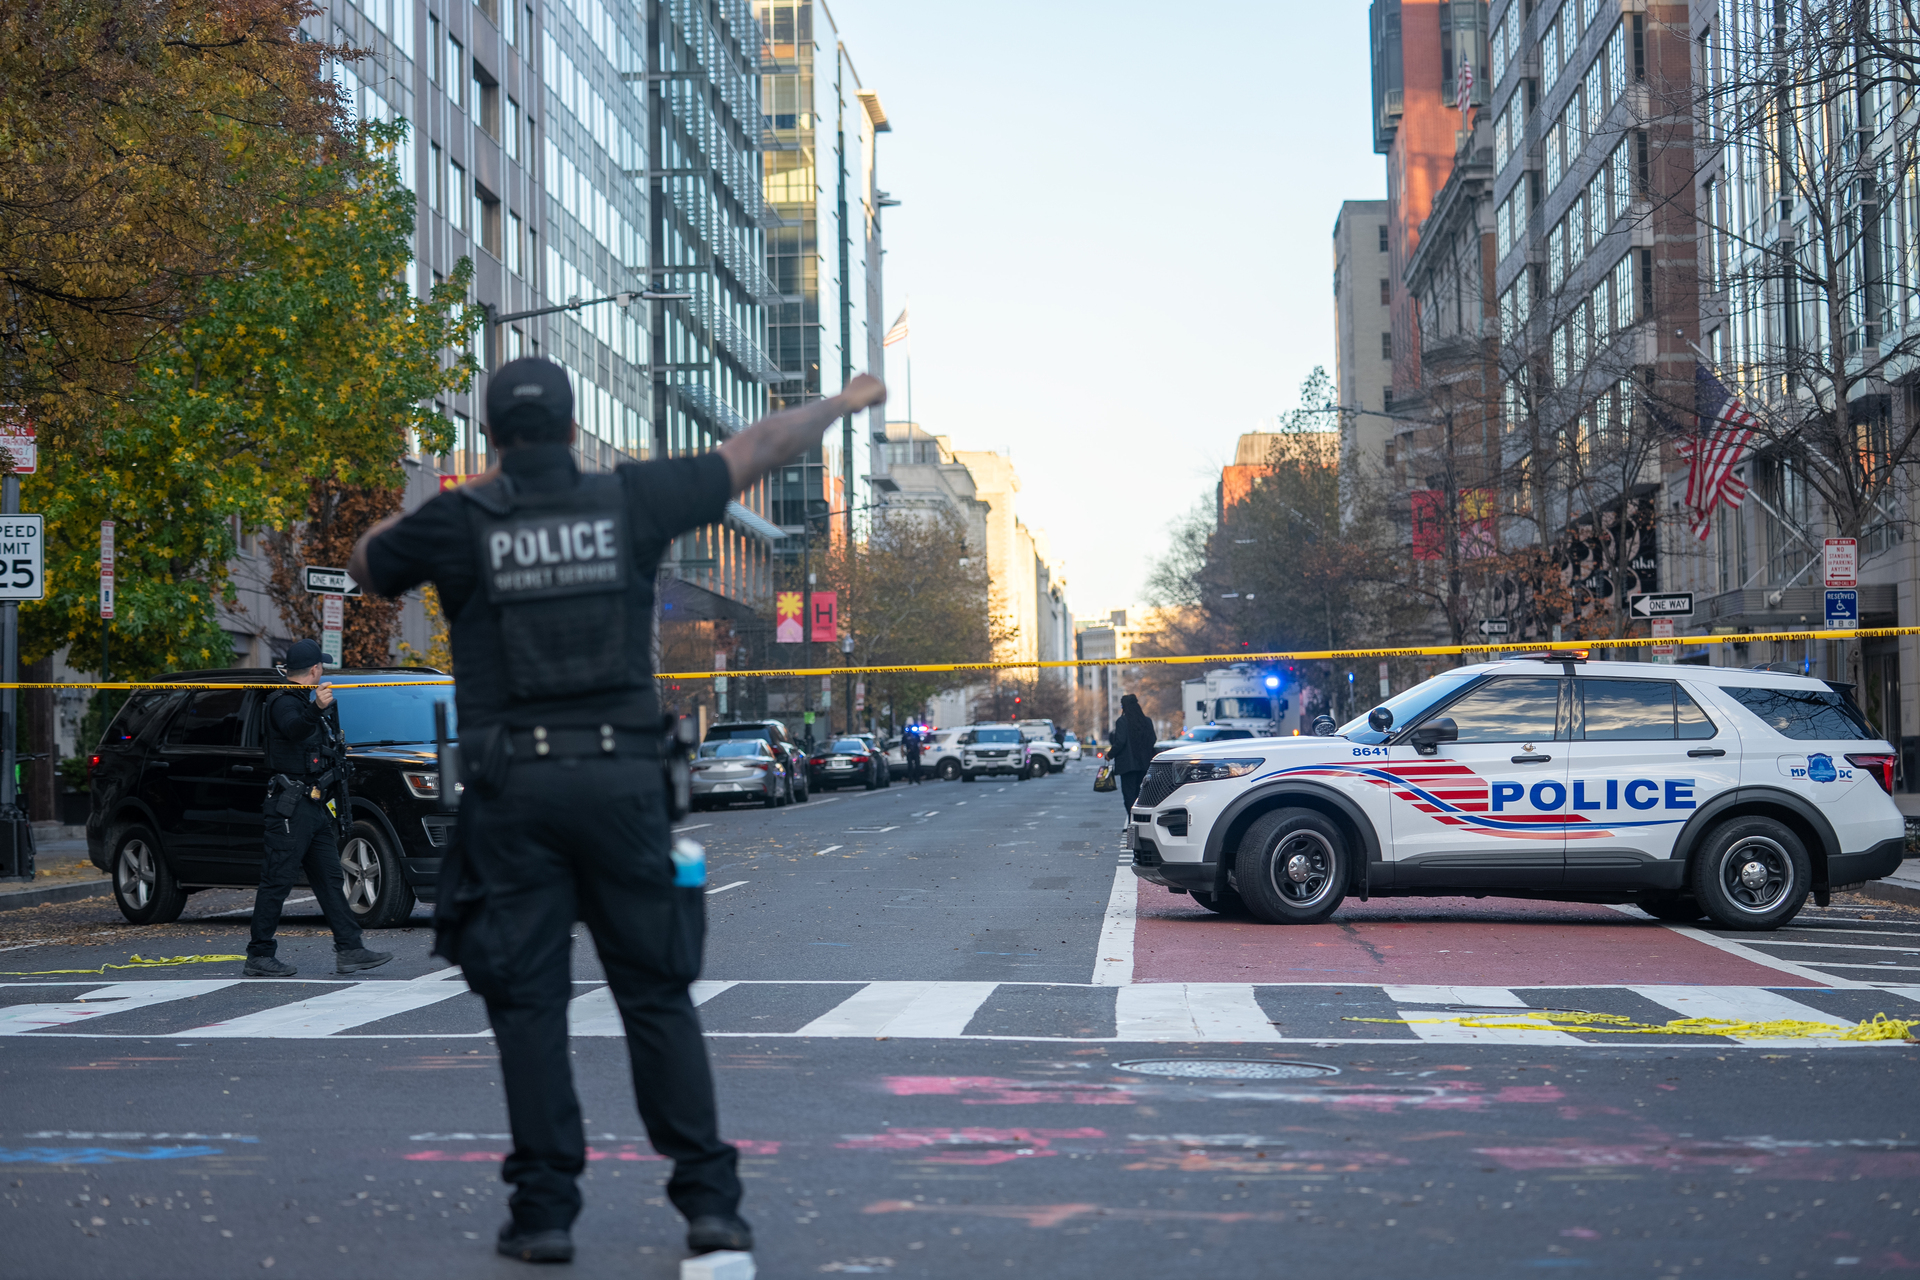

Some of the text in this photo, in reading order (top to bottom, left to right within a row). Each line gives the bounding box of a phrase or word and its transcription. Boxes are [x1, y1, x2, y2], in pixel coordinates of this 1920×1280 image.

[489, 519, 618, 571] POLICE
[312, 574, 346, 586] ONE WAY
[1650, 600, 1686, 610] ONE WAY
[816, 604, 832, 623] H
[1352, 748, 1388, 756] 8641
[1791, 768, 1806, 777] MP
[1839, 770, 1852, 778] DC
[1492, 778, 1696, 812] POLICE
